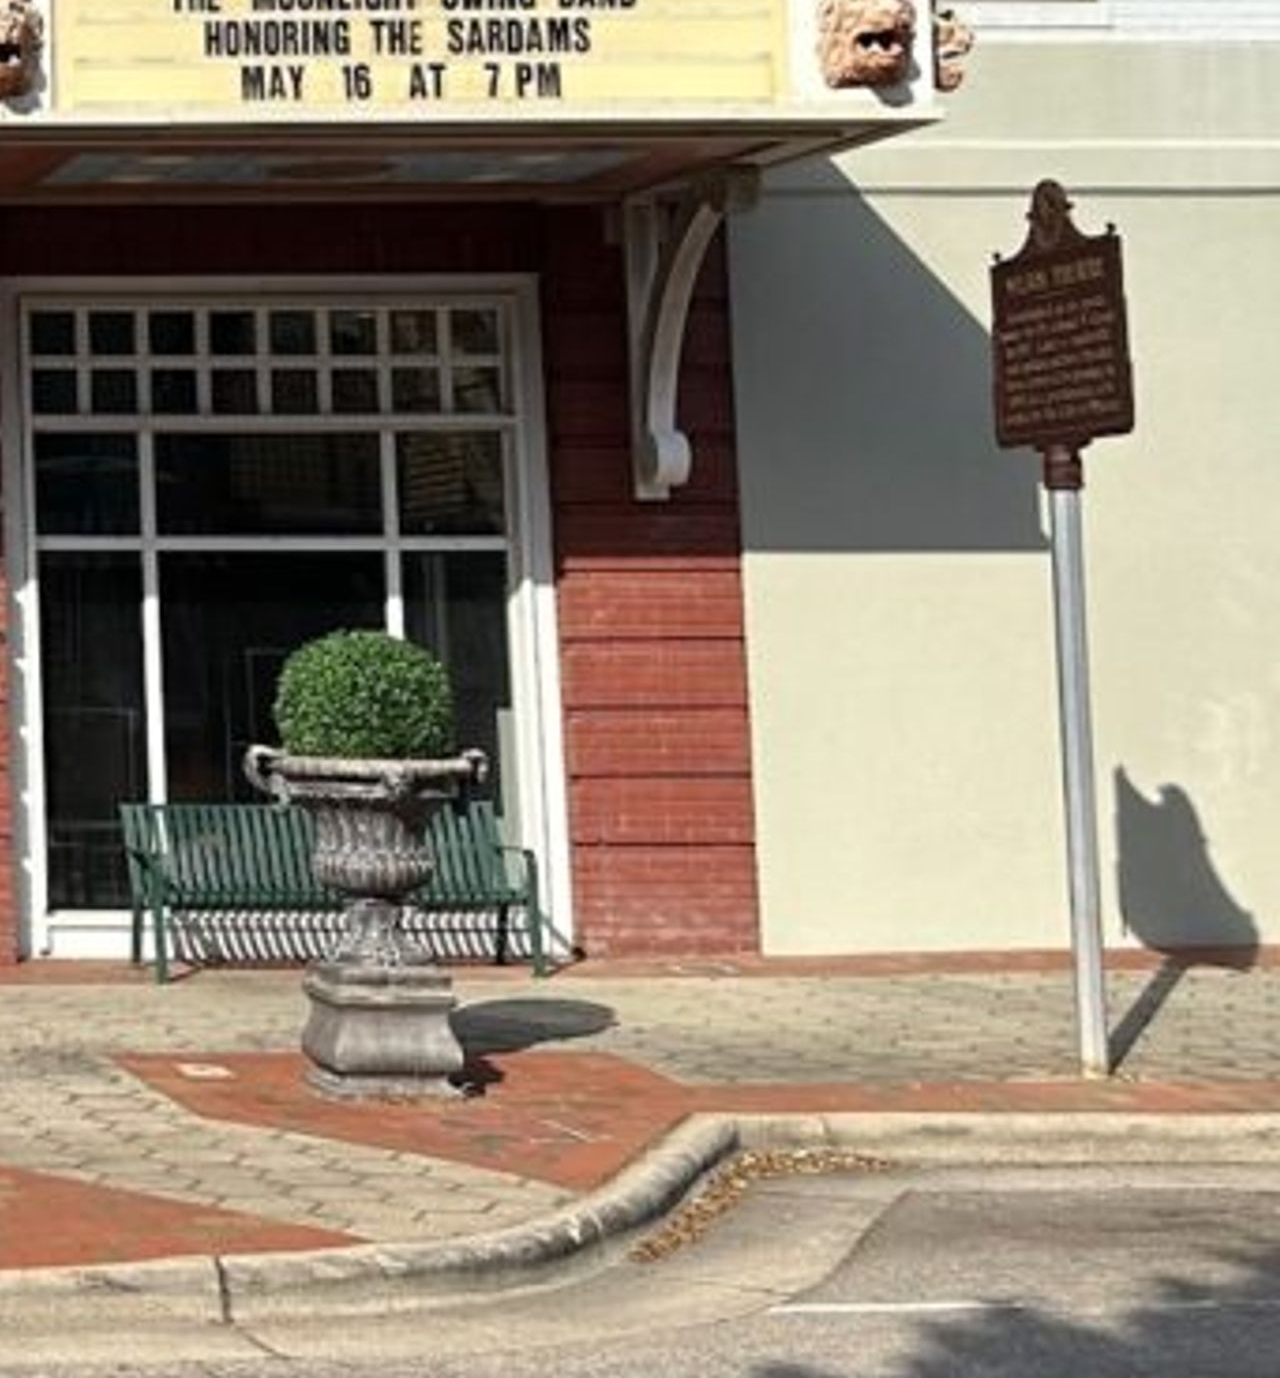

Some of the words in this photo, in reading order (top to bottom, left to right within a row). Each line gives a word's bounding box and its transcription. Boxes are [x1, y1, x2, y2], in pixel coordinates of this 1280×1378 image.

[205, 19, 351, 57] HONORING
[369, 19, 422, 55] THE
[447, 17, 591, 55] SARDAMS
[241, 65, 304, 101] MAY
[342, 63, 372, 100] 16
[409, 63, 446, 99] AT
[484, 62, 500, 98] 7
[515, 62, 562, 98] PM
